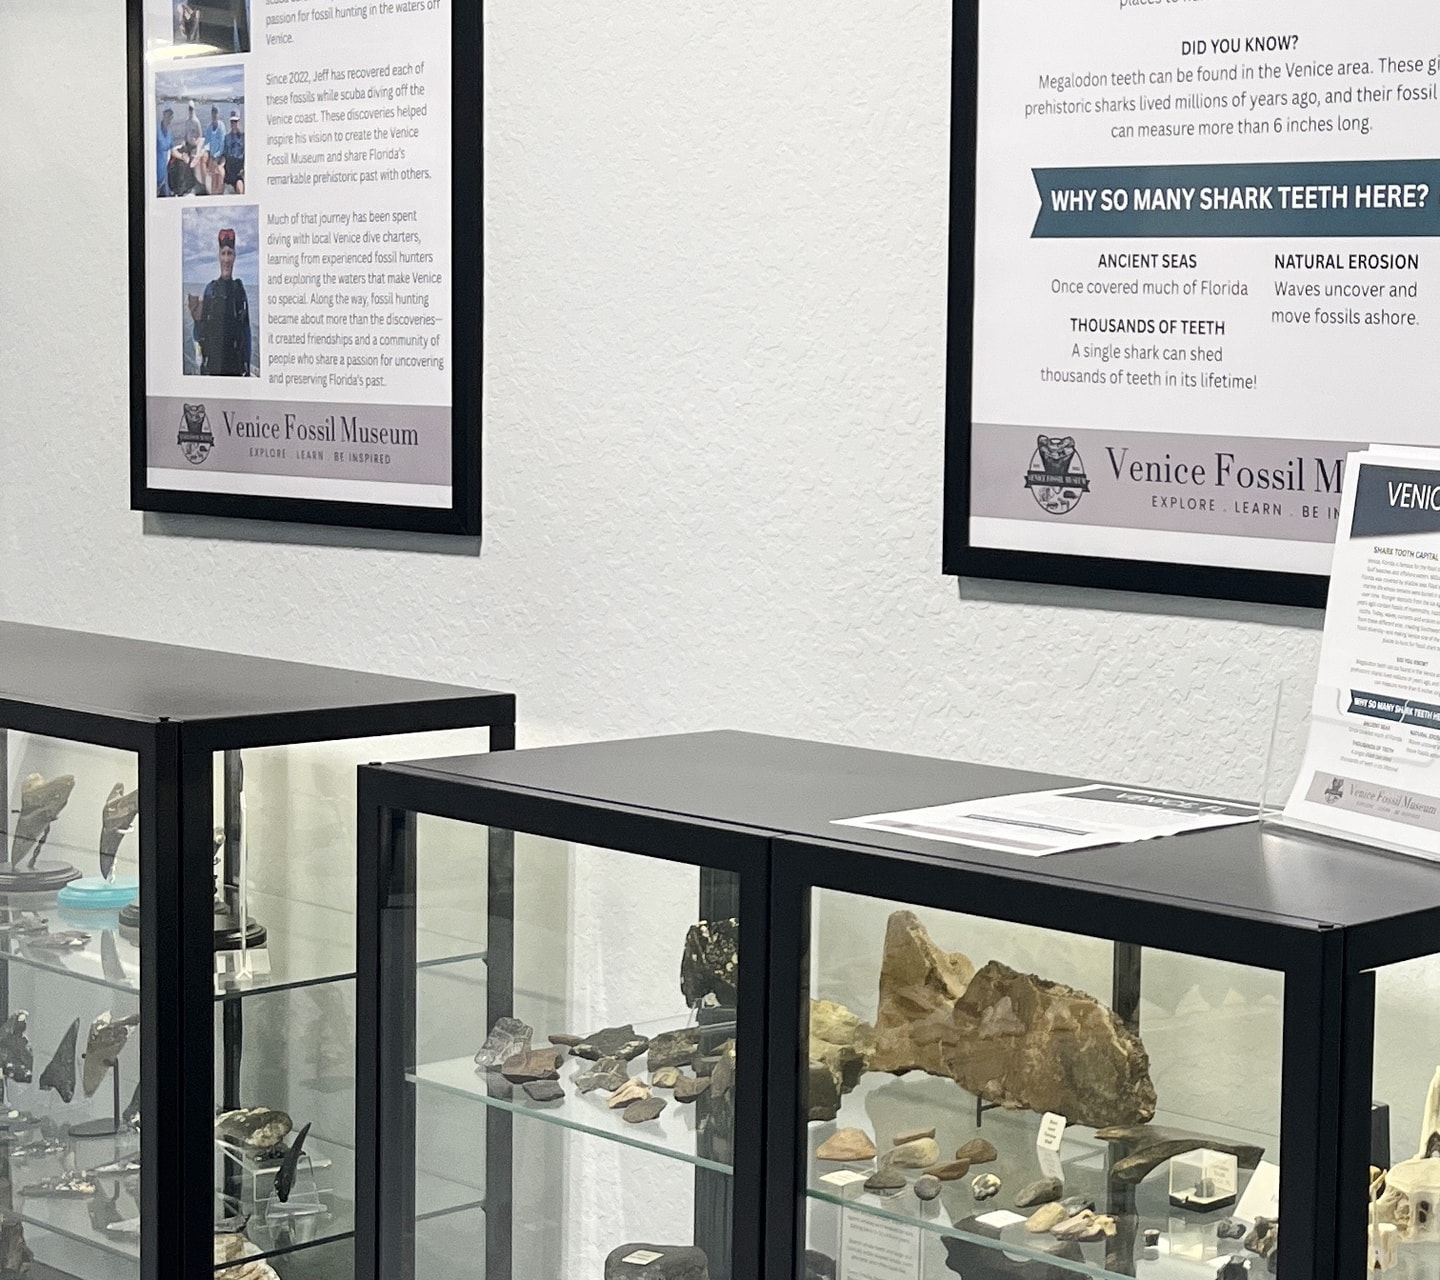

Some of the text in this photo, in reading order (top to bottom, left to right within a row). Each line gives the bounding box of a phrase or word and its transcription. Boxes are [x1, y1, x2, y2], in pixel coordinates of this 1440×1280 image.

[1181, 33, 1298, 55] DID YOU KNOW?
[1038, 71, 1107, 92] Megalodon
[1110, 69, 1145, 86] teeth
[1148, 71, 1172, 84] can
[1176, 67, 1193, 83] be
[1196, 64, 1237, 81] found
[1241, 66, 1254, 79] in
[1257, 62, 1281, 79] the
[1284, 61, 1333, 78] Venice
[1336, 61, 1374, 75] area.
[1377, 56, 1423, 73] These
[1050, 183, 1429, 211] WHY SO MANY SHARK TEETH HERE?
[1097, 253, 1197, 268] ANCIENT SEAS
[1274, 253, 1418, 269] NATURAL EROSION
[1050, 277, 1248, 296] Once covered much of Florida
[1274, 280, 1417, 298] Waves uncover and
[1069, 317, 1225, 335] THOUSANDS OF TEETH
[1271, 307, 1419, 326] move fossils ashore.
[1071, 342, 1222, 363] A single shark can shed
[1040, 366, 1257, 389] thousands of teeth in its lifetime!
[221, 410, 418, 445] Venice Fossil Museum
[248, 446, 391, 464] EXPLORE LEARN BE INSPIRED
[1104, 446, 1205, 485] Venice
[1214, 452, 1305, 491] Fossil
[1150, 494, 1216, 513] EXPLORE
[1233, 499, 1283, 517] LEARN
[1301, 503, 1321, 520] BE
